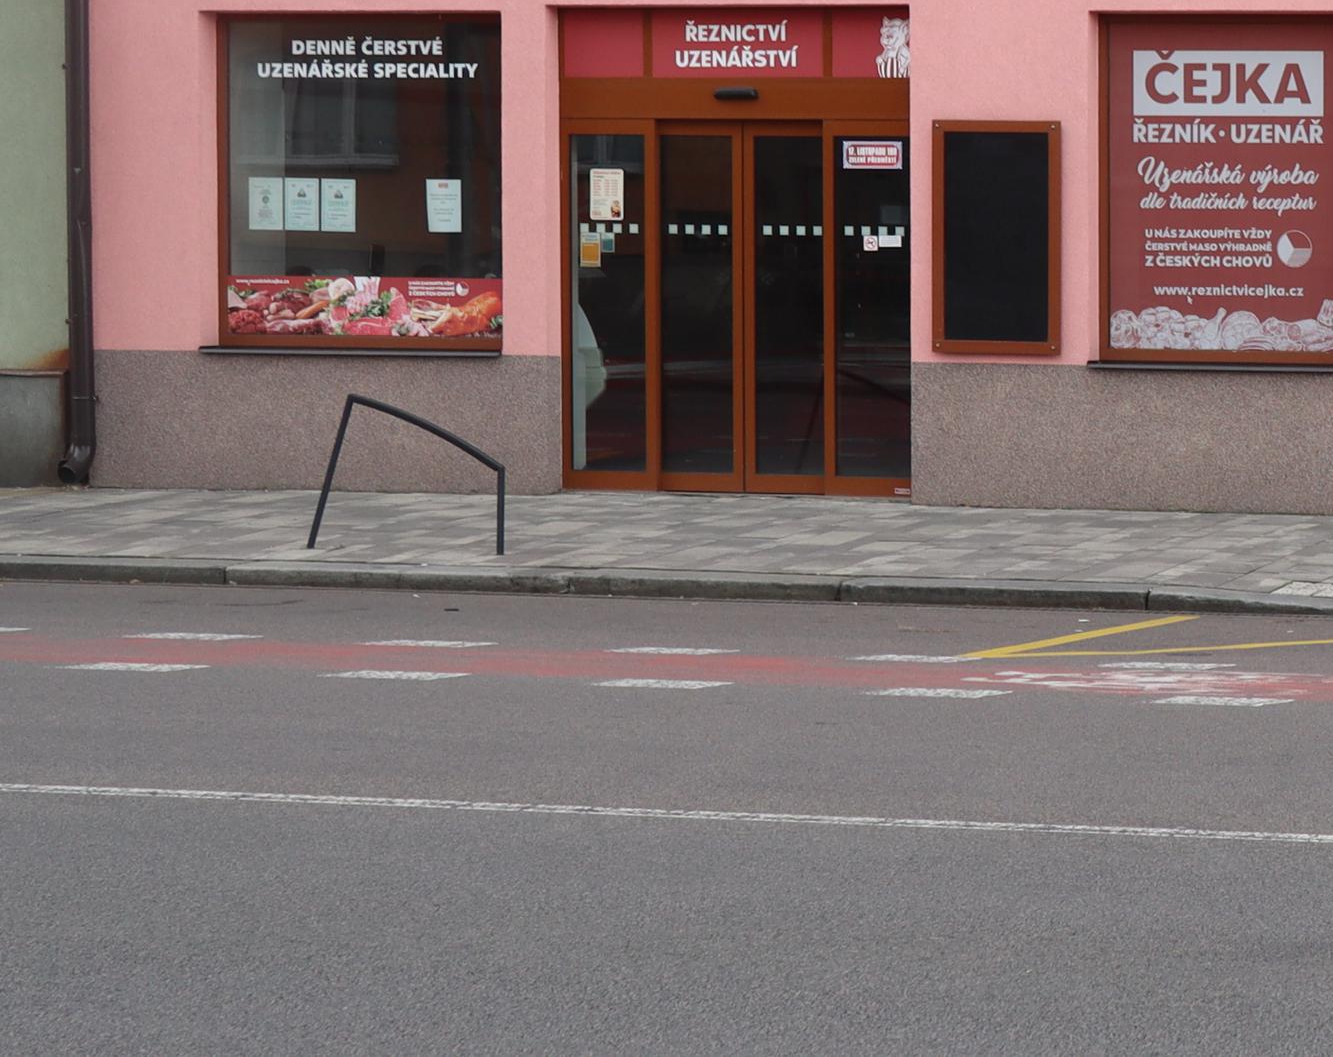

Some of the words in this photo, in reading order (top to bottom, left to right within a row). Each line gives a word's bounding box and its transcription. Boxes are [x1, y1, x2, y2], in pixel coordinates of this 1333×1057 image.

[685, 20, 788, 42] ŘEZNICTVÍ
[291, 36, 356, 56] DENNĚ
[361, 36, 443, 56] ČERSTVÉ
[675, 45, 799, 68] UZENÁŘSTVÍ
[257, 59, 369, 79] UZENÁŘSKÉ
[373, 62, 478, 79] SPECIALITY
[1145, 50, 1312, 104] ČEJKA
[1133, 118, 1216, 144] ŘEZNÍK
[1230, 118, 1325, 144] UZENÁŘ
[1137, 156, 1245, 193] Uzenářská
[1249, 162, 1320, 194] výroba
[1139, 192, 1166, 210] dle
[1169, 192, 1248, 211] tradičních
[1251, 195, 1317, 218] receptur
[1145, 229, 1153, 239] U
[1154, 227, 1178, 239] NÁS
[1242, 227, 1273, 240] VŽDY
[1145, 255, 1154, 267] Z
[1156, 253, 1221, 268] ČESKÝCH
[1222, 254, 1273, 268] CHOVŮ
[1153, 284, 1304, 299] www.reznictvicejka.cz
